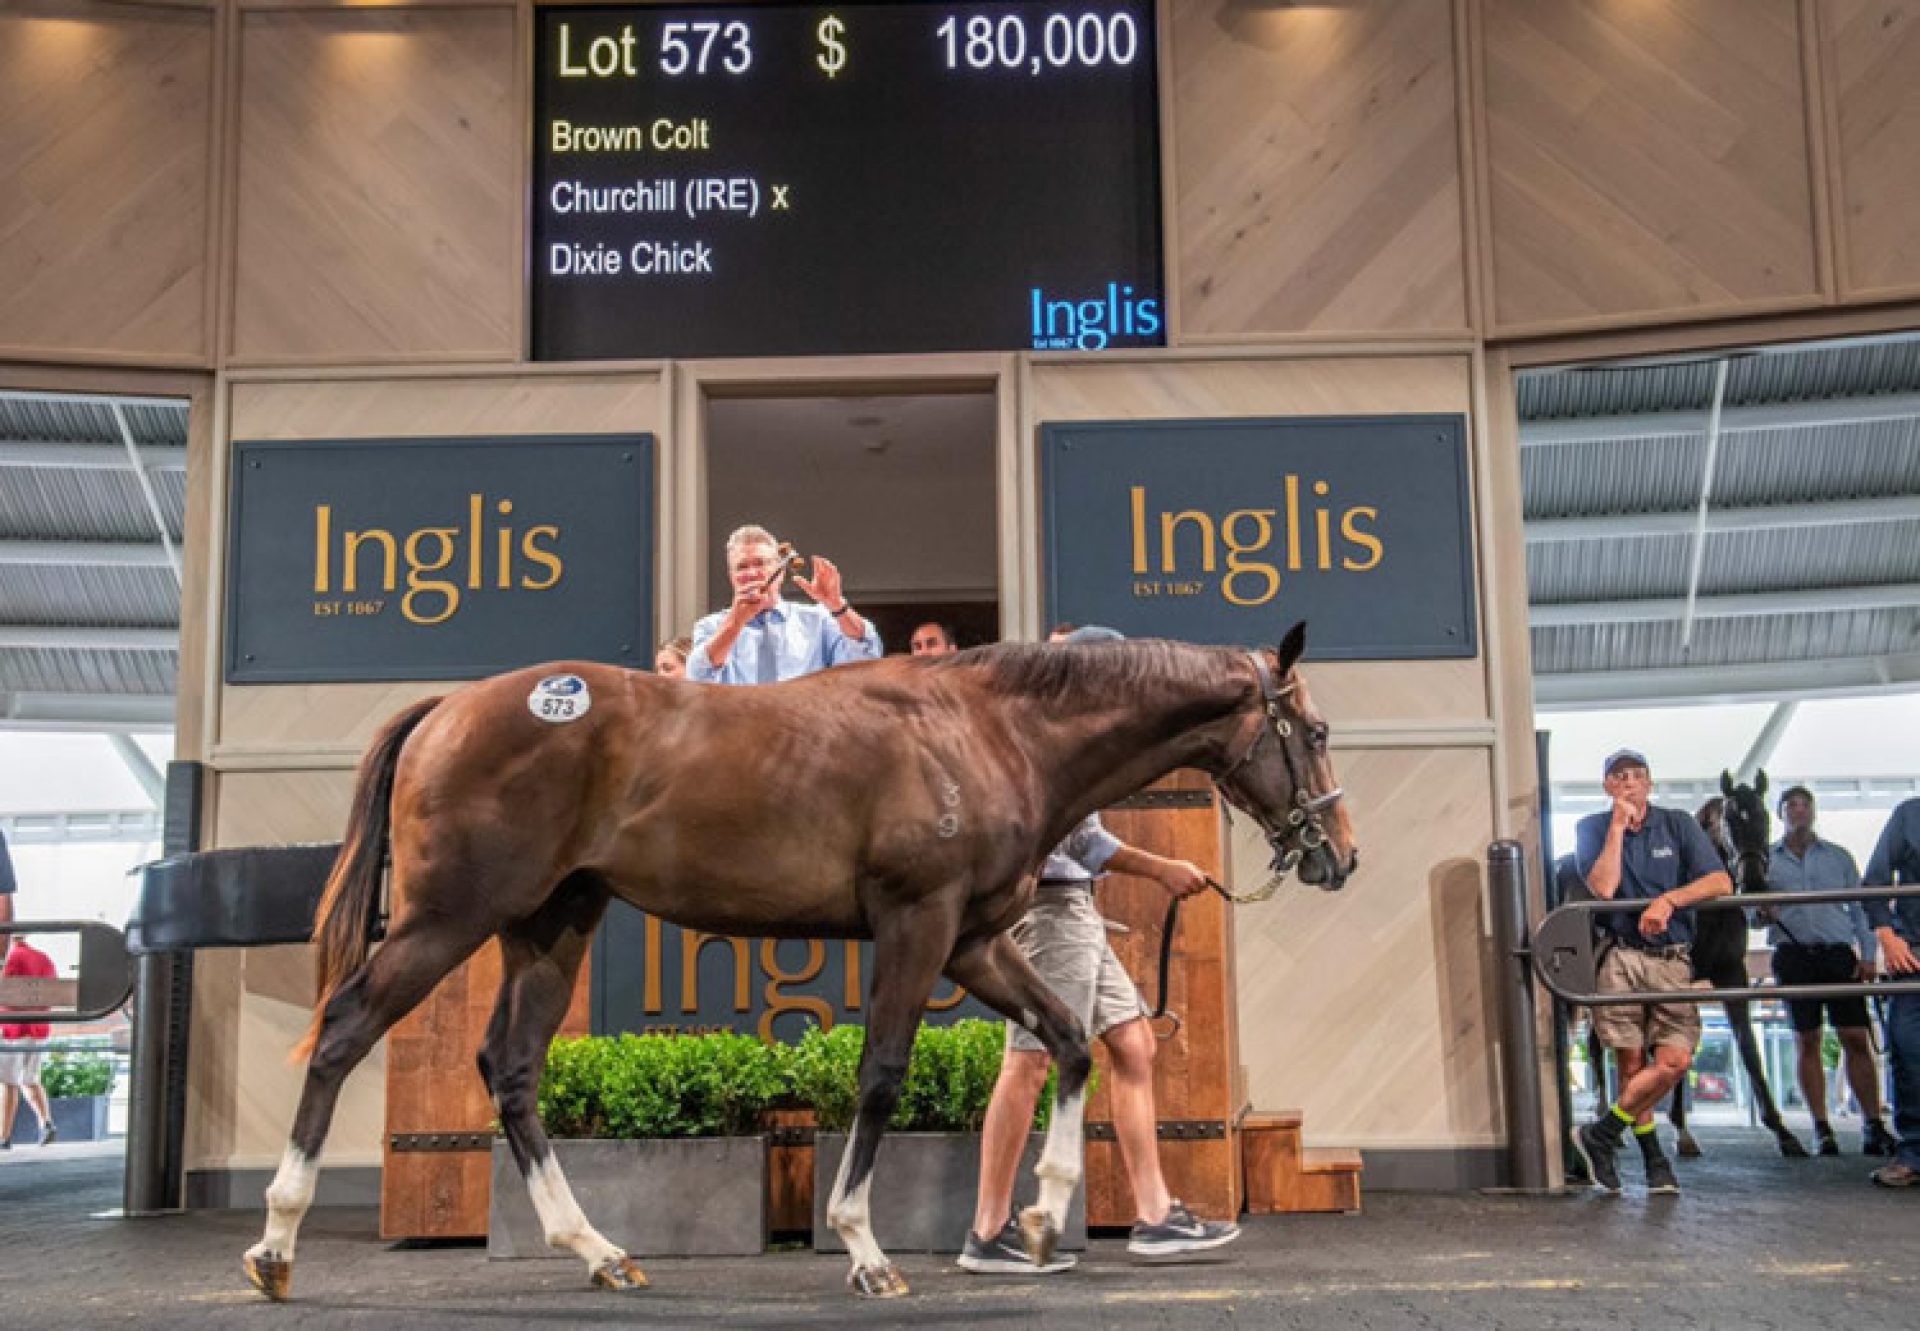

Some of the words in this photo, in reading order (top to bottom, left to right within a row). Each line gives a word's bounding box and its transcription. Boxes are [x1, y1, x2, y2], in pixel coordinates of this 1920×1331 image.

[559, 23, 637, 77] Lot
[659, 20, 751, 75] 573
[816, 14, 847, 78] $
[936, 12, 1137, 76] 180,000
[552, 119, 641, 152] Brown
[652, 117, 709, 150] Colt
[551, 180, 677, 213] Churchill
[685, 178, 759, 218] (IRE)
[771, 184, 789, 210] x
[551, 242, 622, 275] Dixie
[631, 240, 712, 273] Chick
[1032, 283, 1159, 350] Inglis
[313, 493, 565, 624] Inglis
[1130, 473, 1384, 605] Inglis
[542, 698, 575, 715] 573
